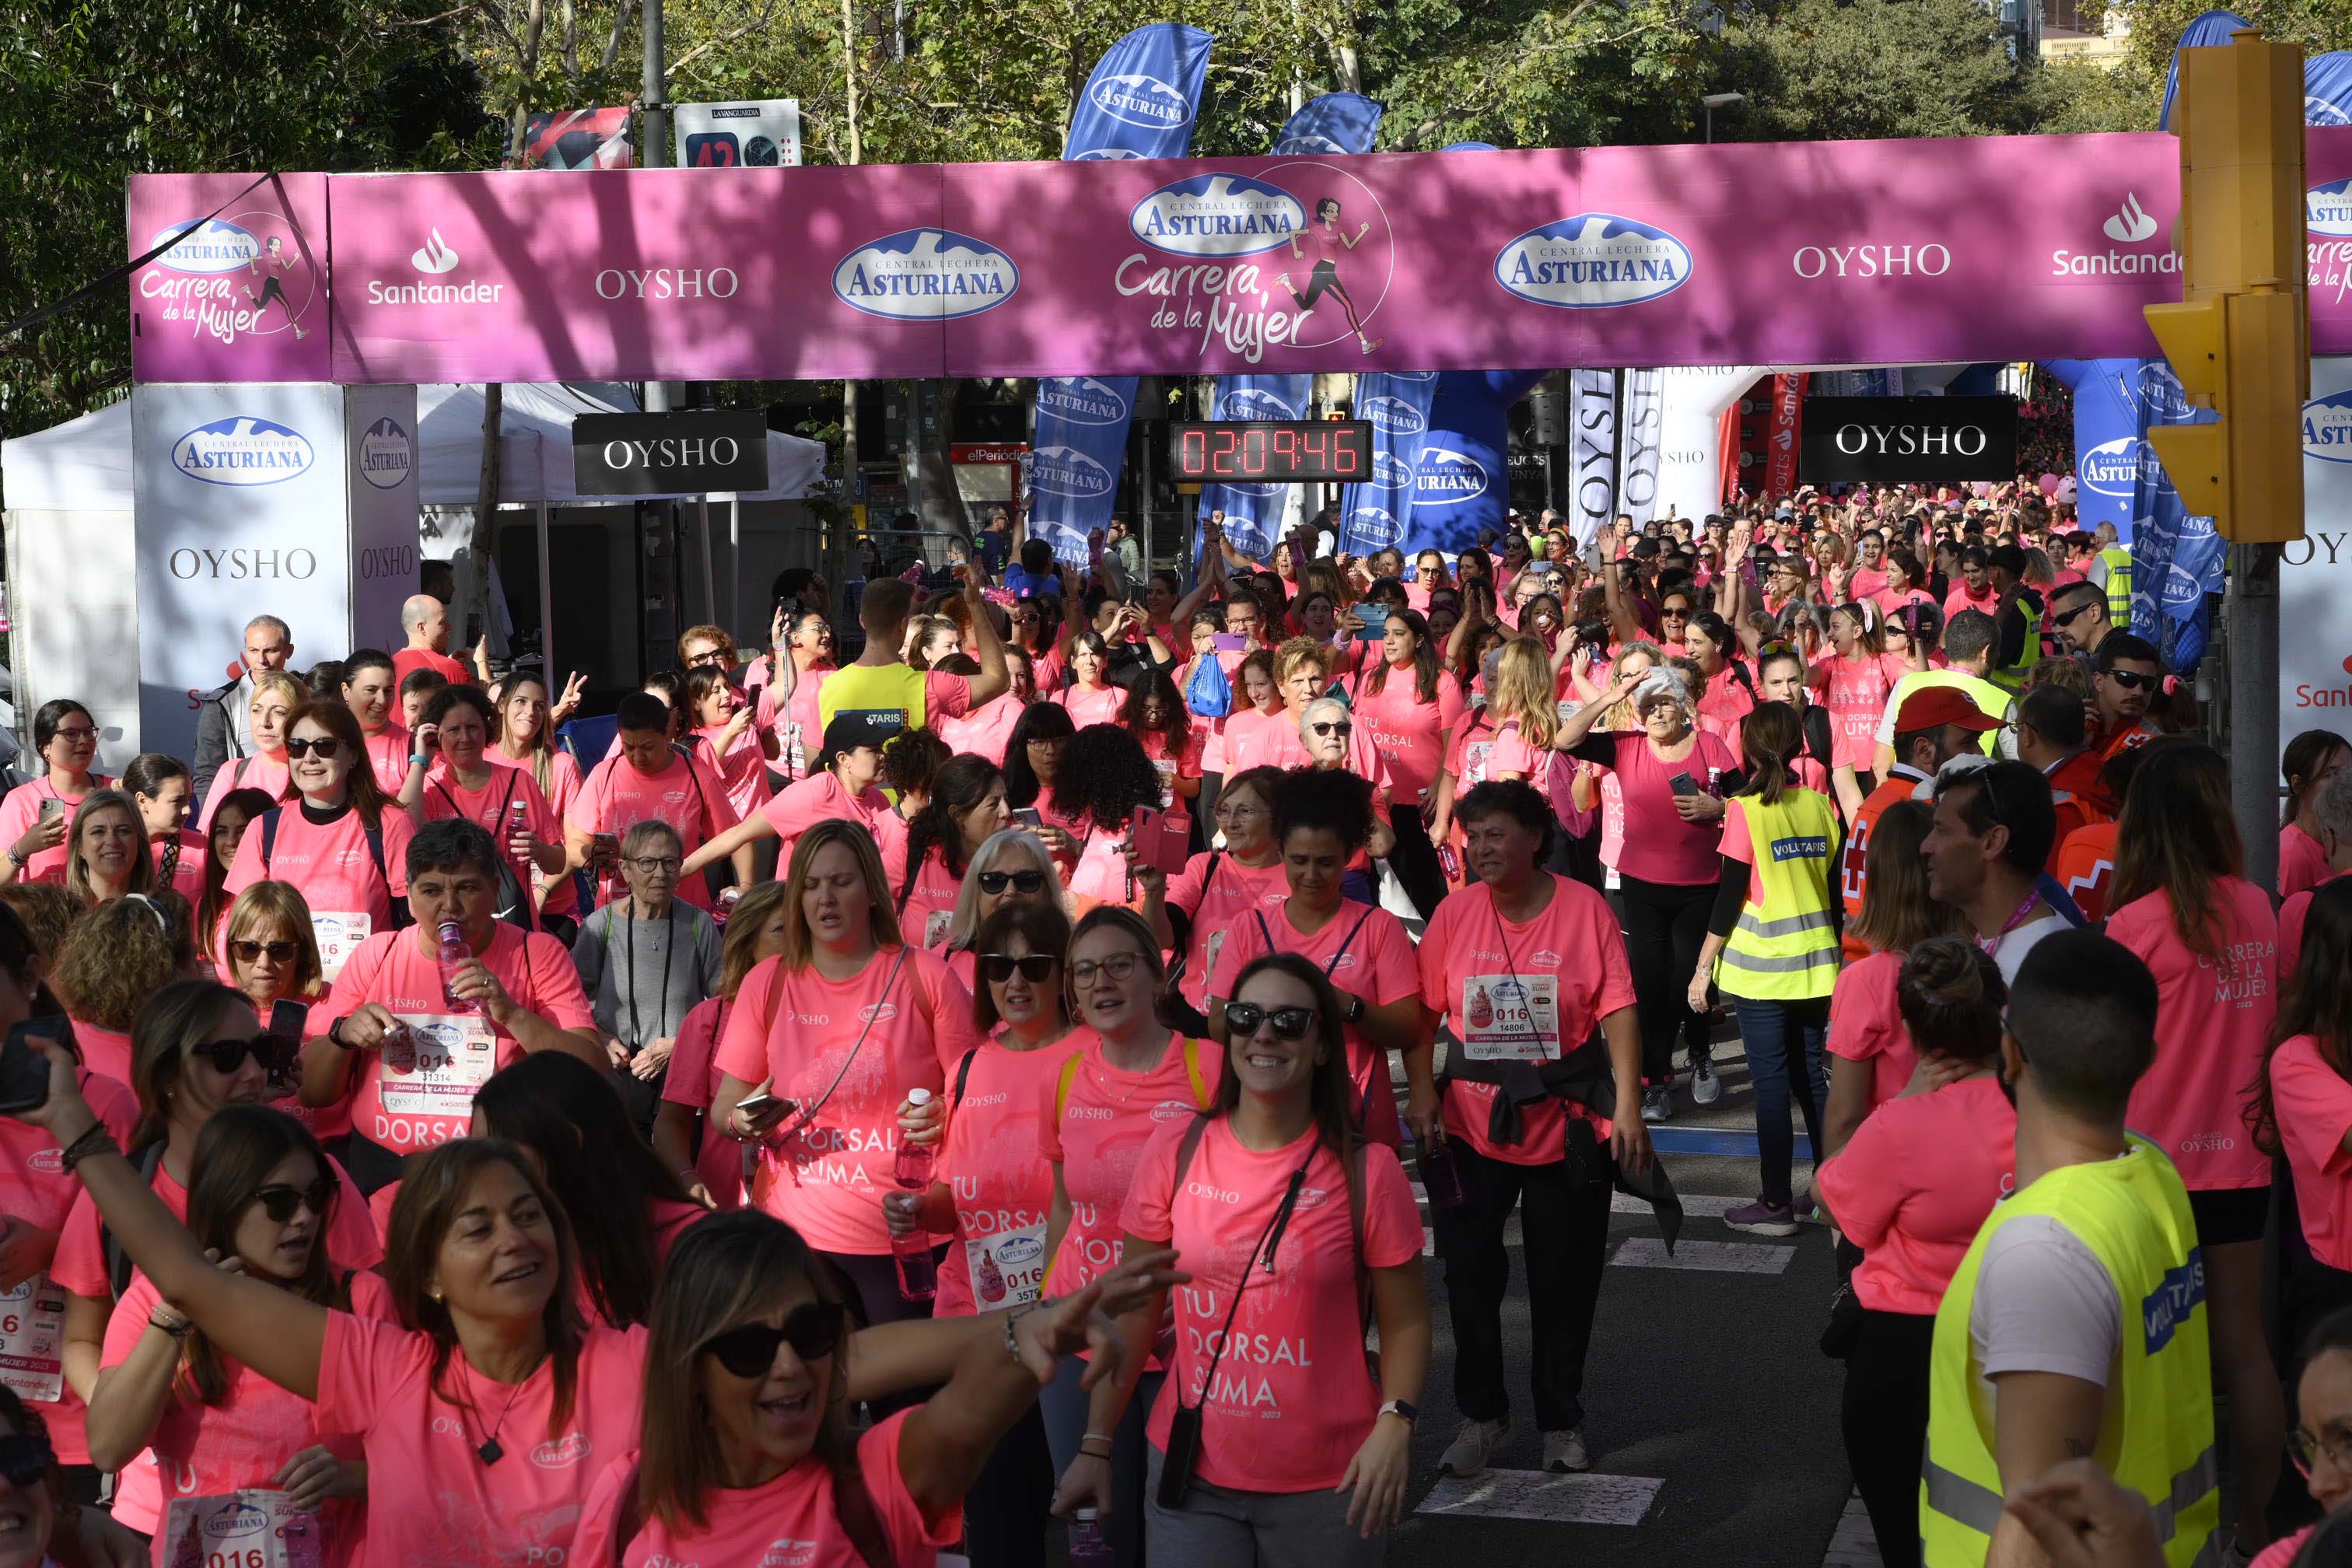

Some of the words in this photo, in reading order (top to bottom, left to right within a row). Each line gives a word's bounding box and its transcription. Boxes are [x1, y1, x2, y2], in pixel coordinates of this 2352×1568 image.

[1097, 85, 1182, 123] ASTURIANA
[1171, 201, 1225, 211] CENTRAL
[1232, 201, 1287, 210] LECHERA
[1143, 205, 1293, 236] ASTURIANA
[1540, 246, 1601, 257] CENTRAL
[1607, 244, 1670, 255] LECHERA
[1793, 243, 1951, 278] OYSHO
[875, 261, 933, 269] CENTRAL
[940, 258, 998, 268] LECHERA
[1115, 254, 1260, 296] Carrera
[1510, 250, 1678, 285] ASTURIANA
[2325, 264, 2340, 287] la
[140, 269, 232, 299] Carrera
[368, 280, 504, 304] Santander
[595, 268, 738, 299] OYSHO
[847, 263, 1005, 296] ASTURIANA
[162, 300, 180, 320] de
[184, 300, 195, 320] la
[194, 295, 267, 345] Mujer
[1150, 299, 1178, 328] de
[1184, 296, 1202, 328] la
[1198, 291, 1314, 364] Mujer
[1037, 384, 1118, 419] ASTURIANA
[1183, 430, 1356, 473] 02:09:46
[1836, 423, 1986, 457] OYSHO
[182, 443, 304, 469] ASTURIANA
[363, 445, 408, 471] ASTURIANA
[604, 436, 739, 470] OYSHO
[361, 544, 413, 579] OYSHO
[2280, 532, 2352, 566] OY
[170, 548, 317, 579] OYSHO
[1365, 717, 1378, 728] TU
[919, 887, 954, 898] OYSHO
[320, 943, 338, 955] 16
[2246, 961, 2265, 979] LA
[2214, 978, 2267, 1003] MUJER
[1496, 1008, 1528, 1020] 016
[419, 1031, 460, 1041] ASTURIANA
[1473, 1046, 1502, 1055] OYSHO
[966, 1092, 1007, 1108] OYSHO
[1069, 1107, 1114, 1120] OYSHO
[375, 1115, 467, 1146] DORSA
[2181, 1138, 2235, 1153] OYSHO
[953, 1176, 978, 1201] TU
[1188, 1181, 1240, 1205] OYSHO
[958, 1209, 1048, 1234] DORSA
[999, 1246, 1039, 1261] ASTURIANA
[1007, 1268, 1043, 1290] 016
[1181, 1286, 1216, 1318] TU
[1188, 1326, 1312, 1367] DORSAL
[4, 1377, 50, 1389] Santander
[1192, 1366, 1277, 1408] SUMA
[1262, 1410, 1281, 1419] 2023
[208, 1518, 264, 1532] ASTURIANA
